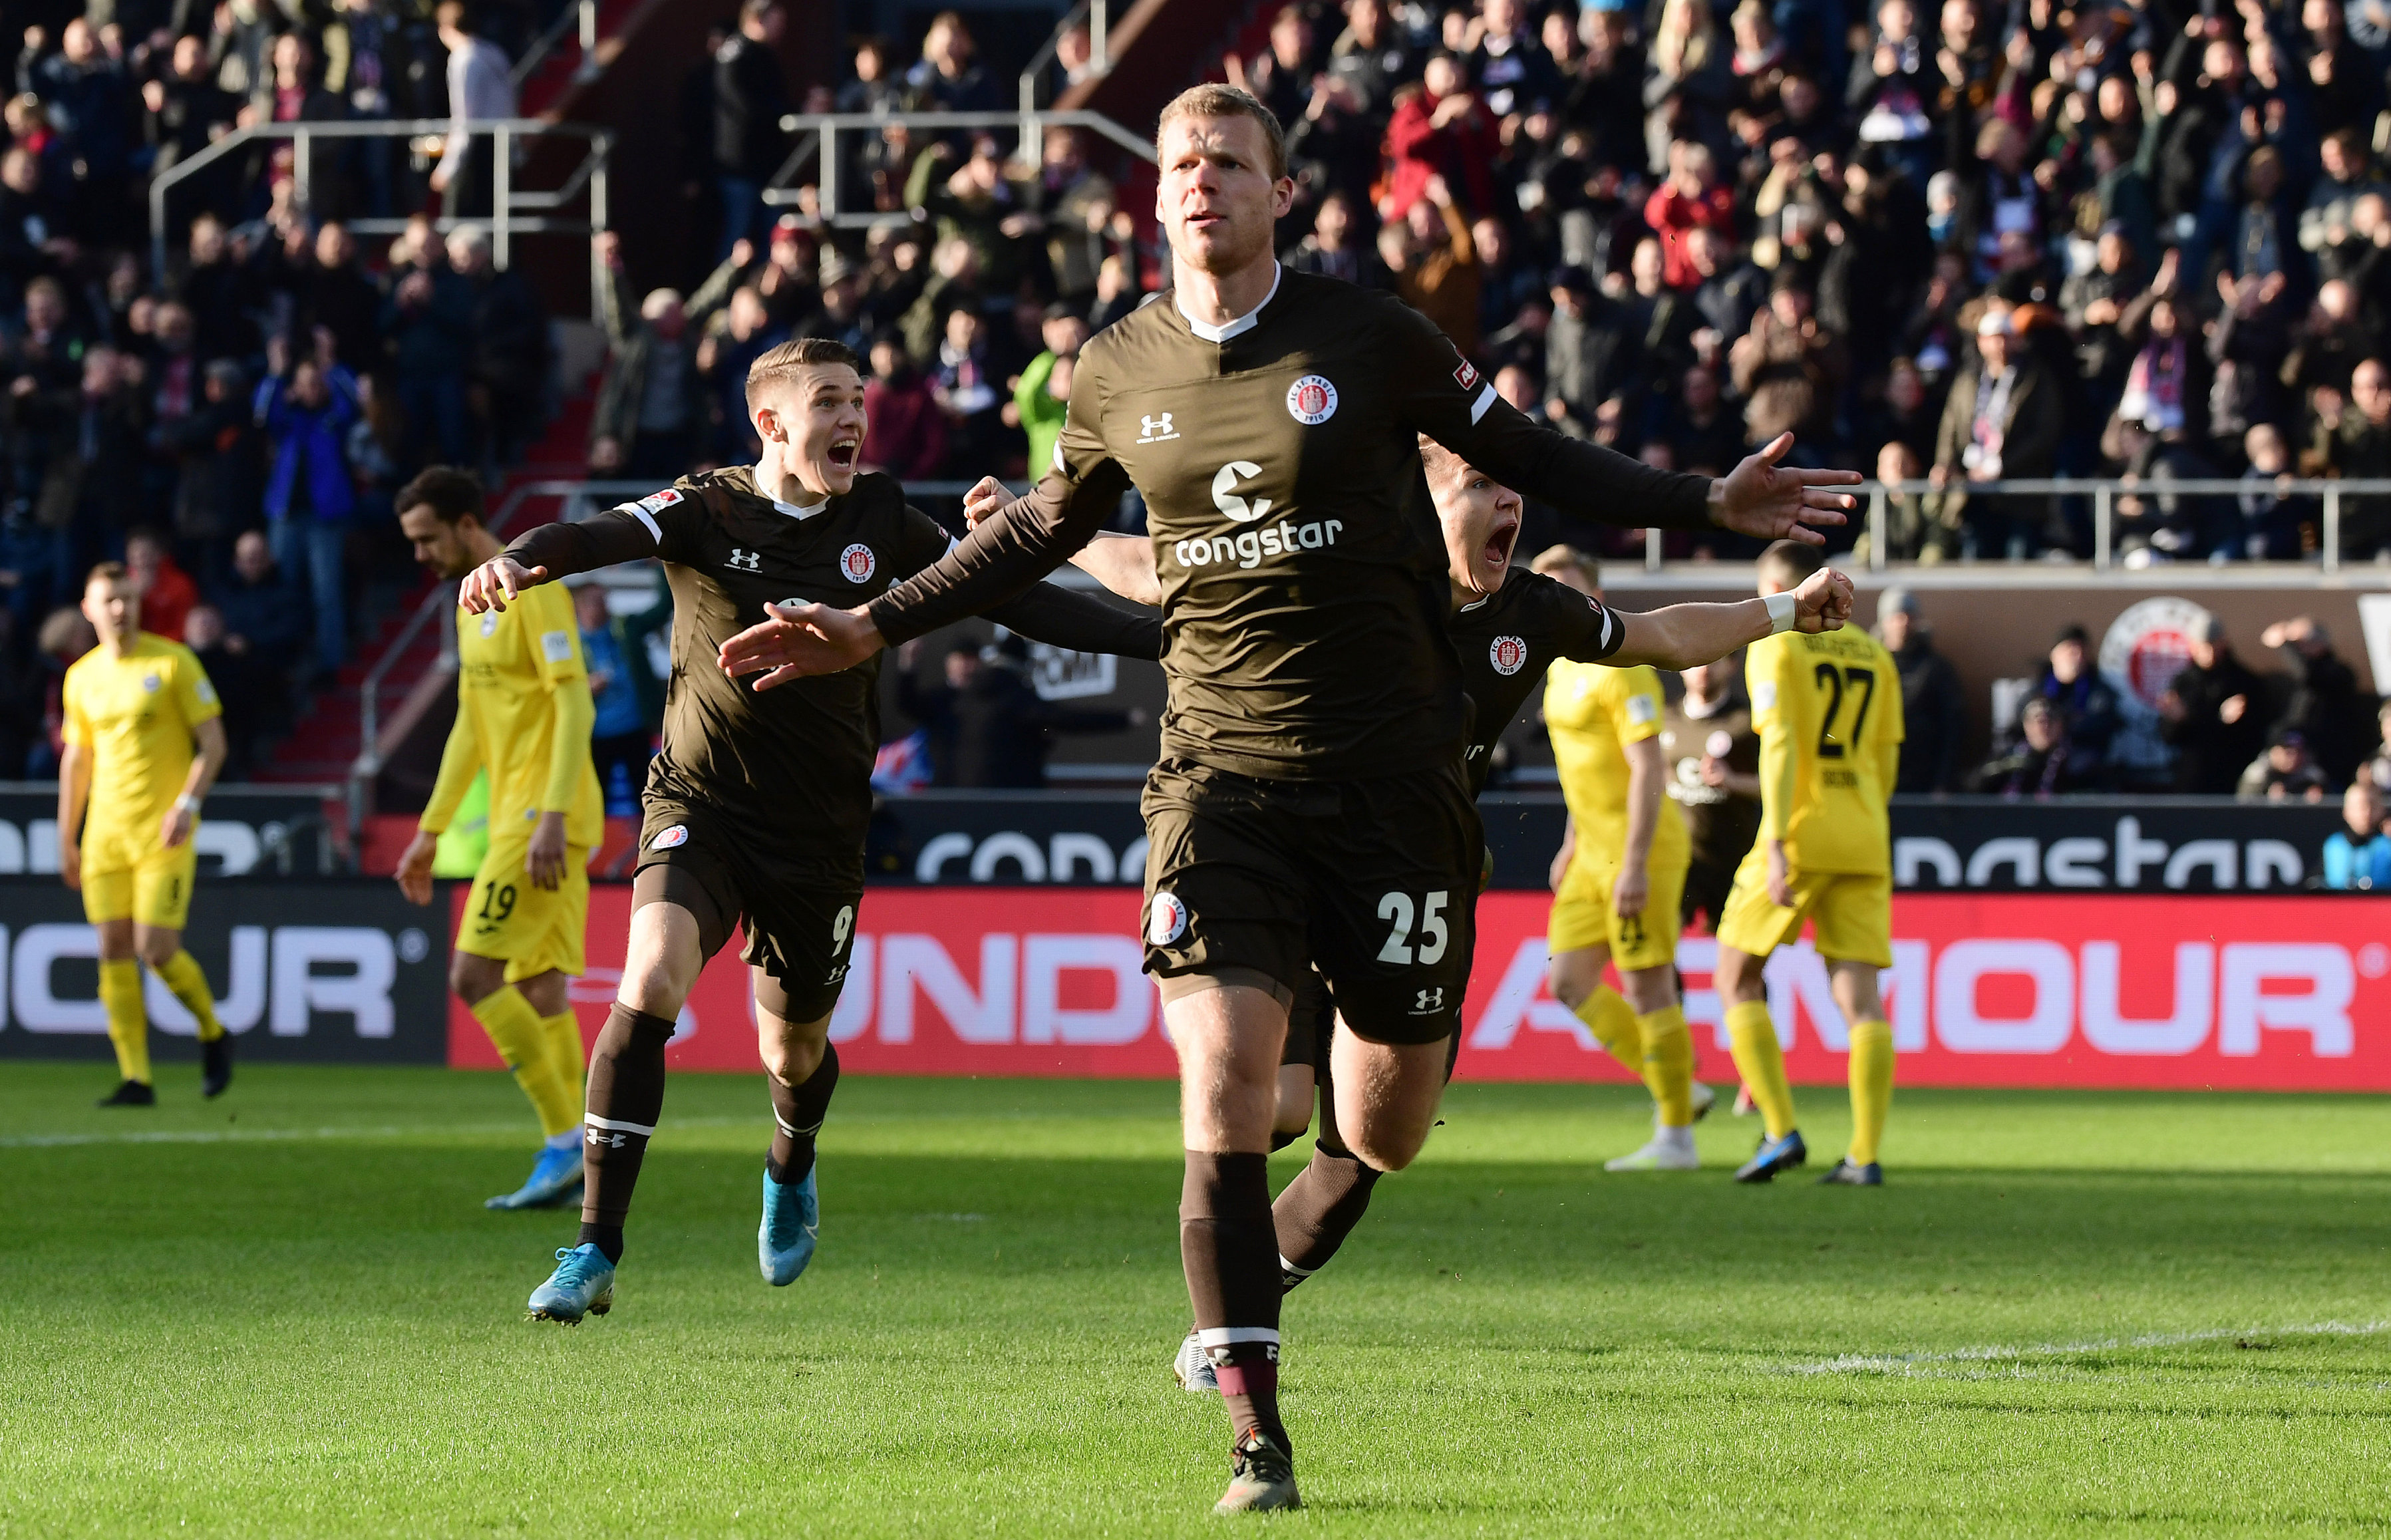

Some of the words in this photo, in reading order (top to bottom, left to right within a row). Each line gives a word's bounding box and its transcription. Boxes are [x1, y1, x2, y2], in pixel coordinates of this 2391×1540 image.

[1311, 377, 1335, 397] PAULI
[1305, 414, 1324, 422] 1910
[1176, 520, 1343, 569] congstar
[1491, 643, 1498, 653] FC
[1508, 636, 1525, 653] PAULI
[1815, 664, 1874, 758] 27
[479, 881, 516, 921] 19
[832, 905, 853, 958] 9
[1376, 890, 1448, 965] 25
